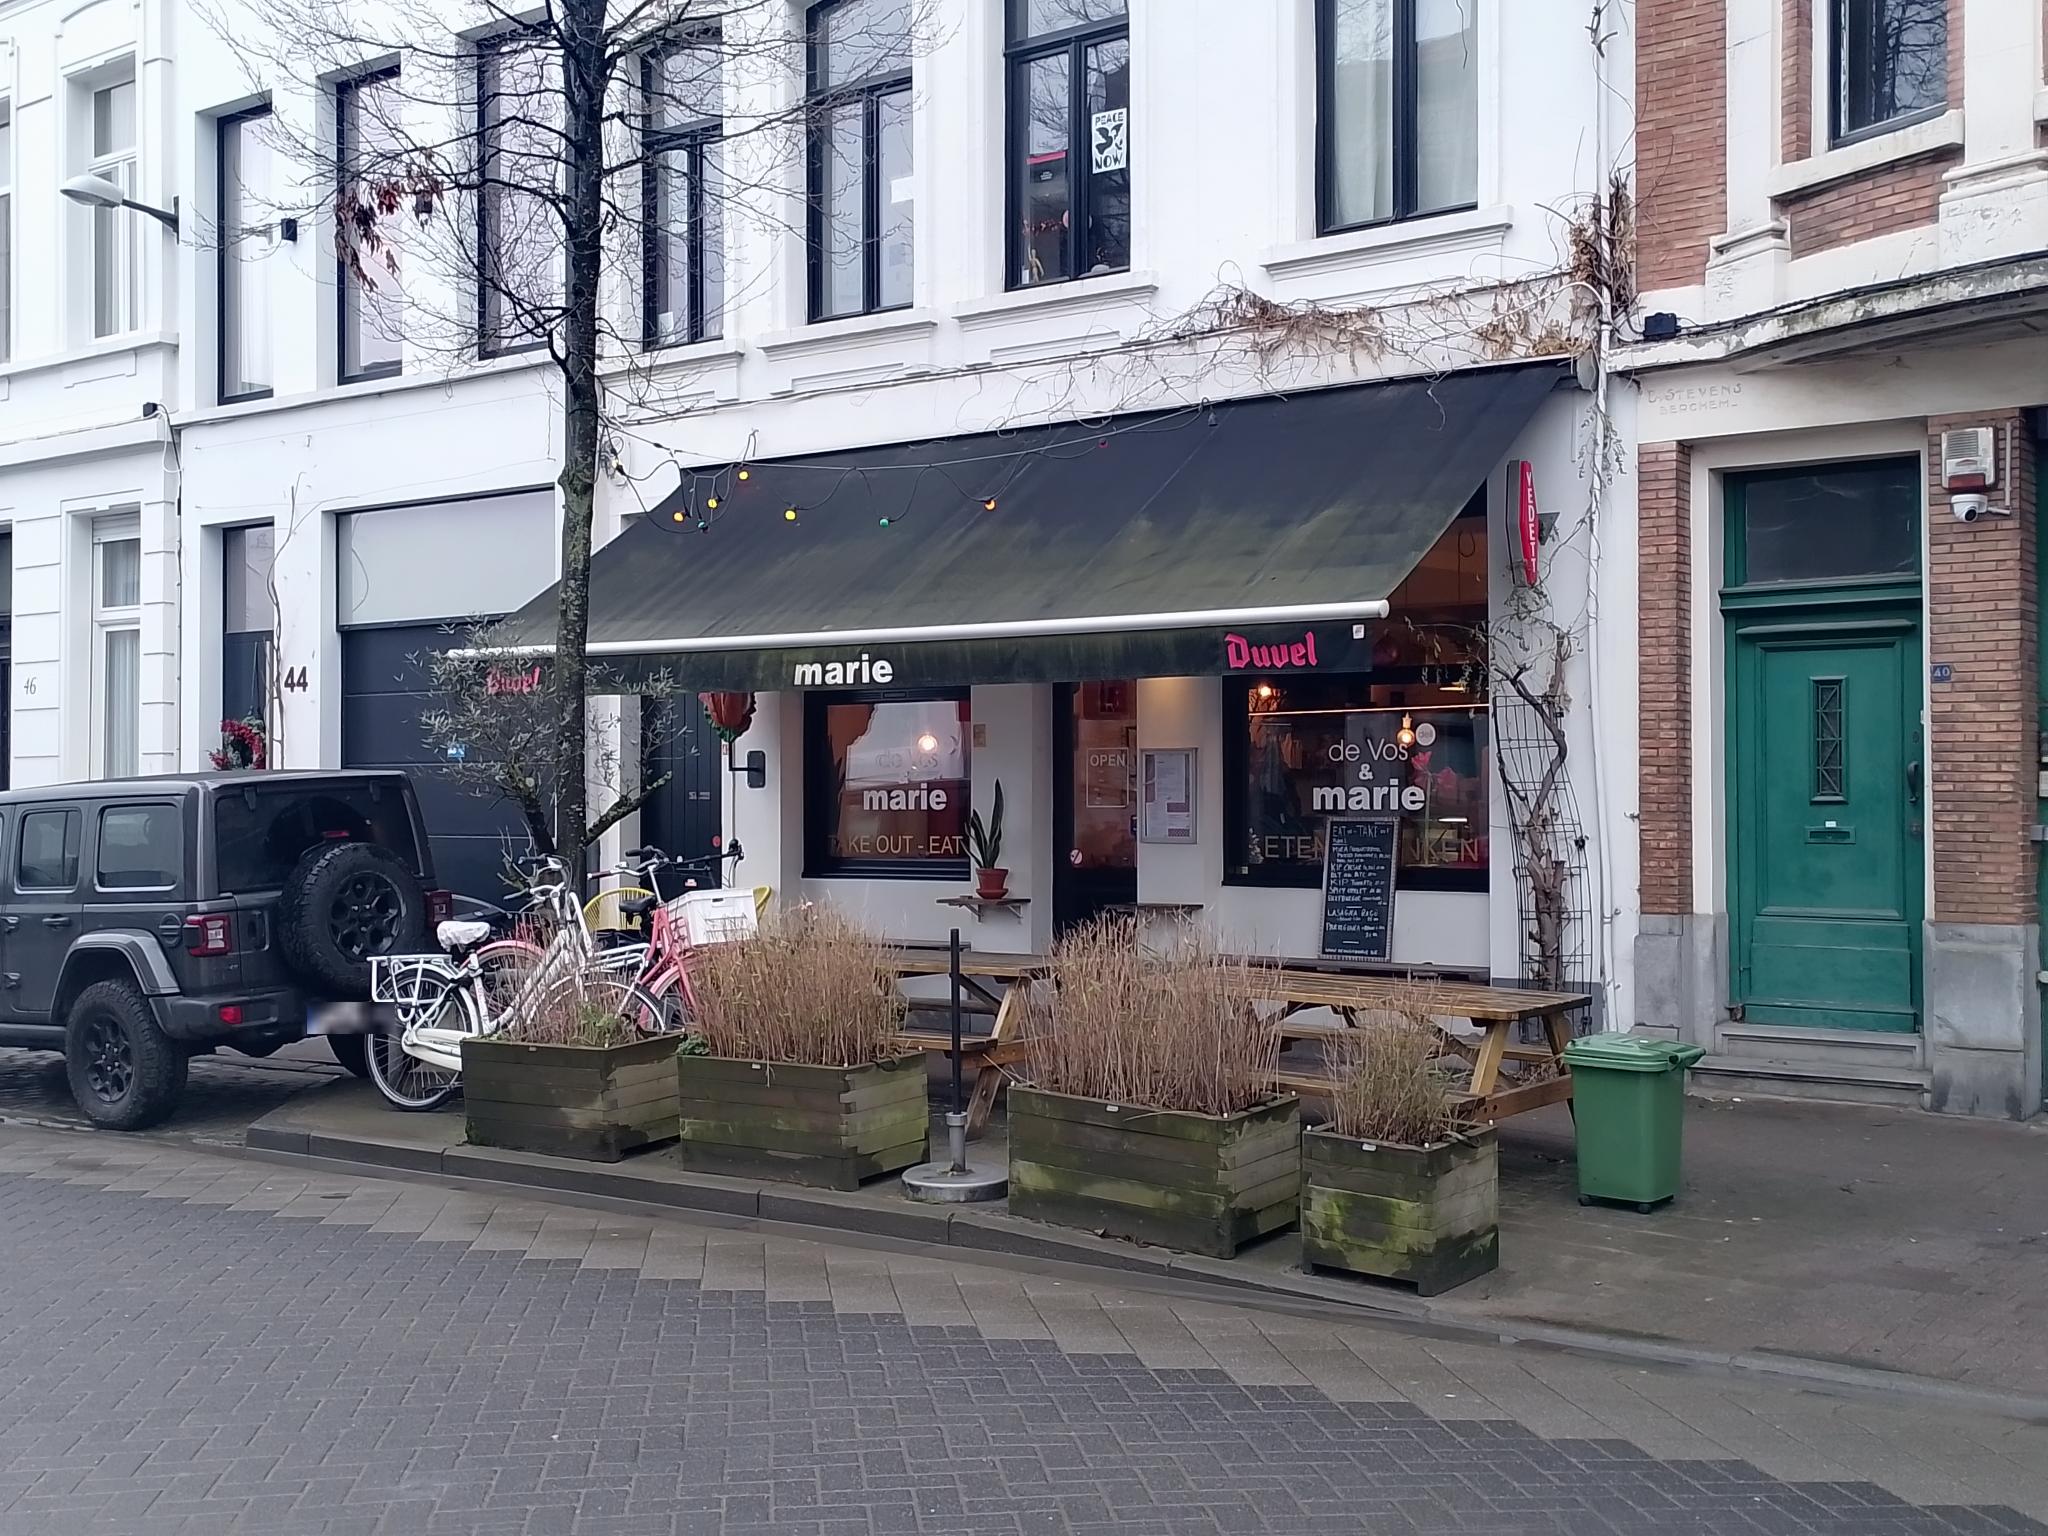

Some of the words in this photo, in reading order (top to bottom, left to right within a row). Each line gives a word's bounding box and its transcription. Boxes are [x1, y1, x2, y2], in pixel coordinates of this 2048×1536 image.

[1095, 111, 1123, 126] PEACE
[1095, 151, 1123, 170] NOW
[1665, 383, 1742, 401] STEVENS
[1526, 471, 1536, 573] VEDETT
[1224, 631, 1318, 669] Duvel
[284, 666, 308, 693] 44
[793, 653, 893, 686] marie
[1934, 666, 1950, 677] 40
[24, 676, 36, 695] 46
[1328, 740, 1360, 761] de
[1367, 738, 1408, 761] Vos
[1089, 754, 1126, 767] OPEN
[1358, 763, 1374, 780] &
[863, 783, 948, 811] marie
[1312, 779, 1425, 811] marie
[876, 834, 914, 854] OUT
[929, 835, 964, 855] EAT
